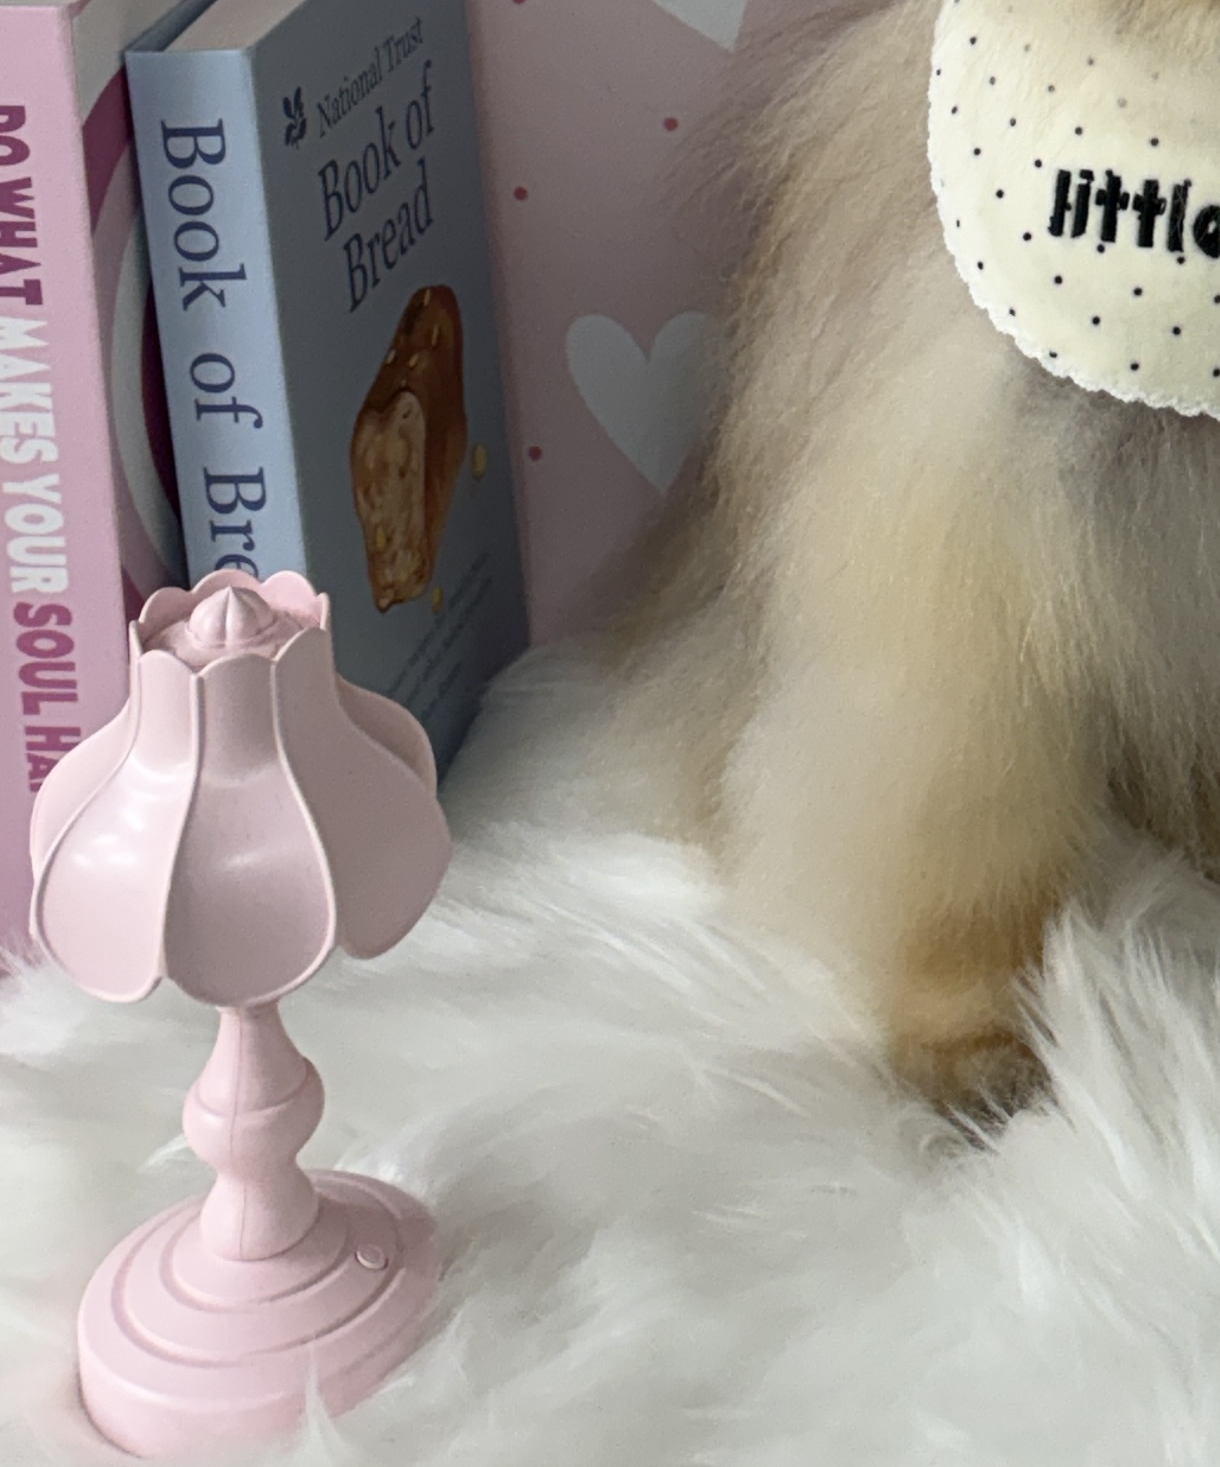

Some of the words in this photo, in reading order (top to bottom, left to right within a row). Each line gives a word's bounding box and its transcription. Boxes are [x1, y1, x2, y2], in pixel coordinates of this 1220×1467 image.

[316, 47, 382, 138] National
[383, 17, 424, 73] Trust
[317, 105, 402, 241] Book
[405, 59, 435, 151] of
[0, 176, 43, 305] WHAT
[160, 118, 247, 311] Book
[342, 156, 434, 313] Bread
[0, 316, 59, 464] MAKES
[189, 352, 263, 429] of
[2, 473, 70, 593] YOUR
[203, 467, 268, 578] Bre
[13, 602, 78, 715] SOUL
[25, 726, 81, 793] HA
